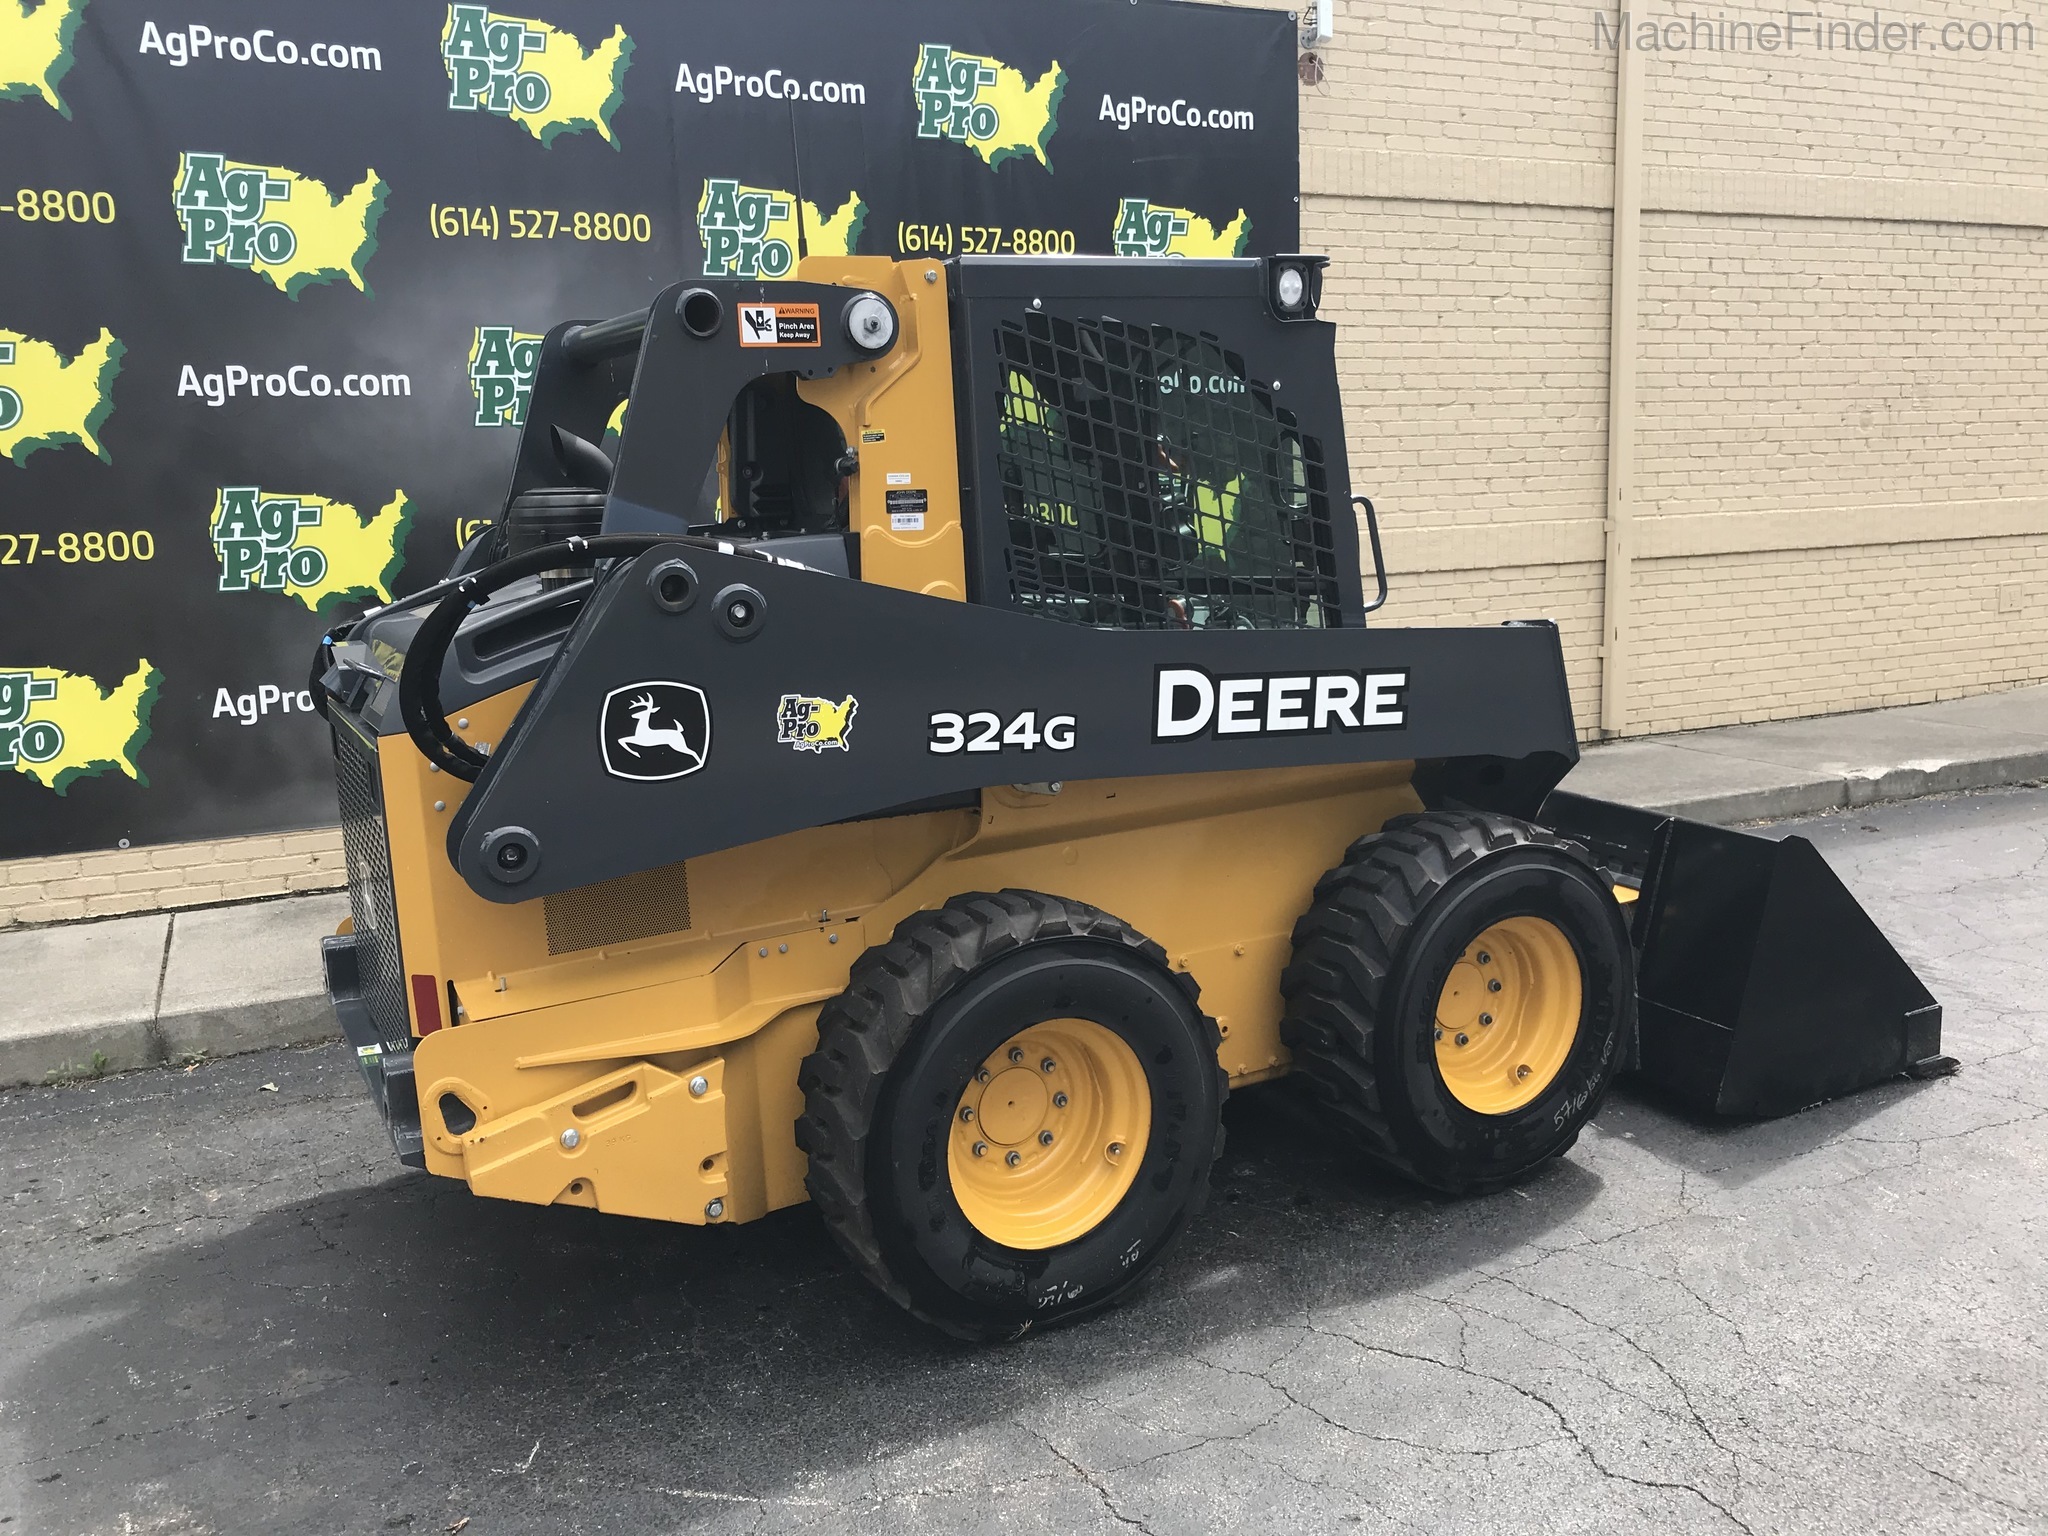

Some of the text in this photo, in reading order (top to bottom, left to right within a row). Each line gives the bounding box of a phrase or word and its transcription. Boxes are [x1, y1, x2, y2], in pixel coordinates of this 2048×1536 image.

[138, 20, 382, 71] AgProCo.com
[445, 4, 546, 72] Ag-
[449, 57, 550, 113] Pro
[674, 62, 866, 105] AgProCo.com
[915, 44, 997, 103] Ag-
[918, 90, 998, 140] Pro
[1098, 93, 1254, 131] AgProCo.com
[0, 188, 116, 224] -8800
[176, 152, 289, 222] Ag-
[699, 179, 789, 240] Ag-
[183, 207, 296, 264] Pro
[429, 203, 651, 242] (614) 527-8800
[897, 221, 1075, 256] (614) 527-8800
[1115, 198, 1189, 253] Ag-
[703, 228, 792, 276] Pro
[778, 322, 815, 330] Pinch Area
[177, 364, 412, 407] AgProCo.com
[213, 487, 321, 549] Ag-
[0, 530, 155, 565] 27-8800
[219, 538, 327, 591] Pro
[781, 697, 820, 722] Ag-
[1157, 669, 1406, 737] DEERE
[781, 718, 820, 739] Pro
[794, 740, 839, 749] AgProCo.com
[929, 711, 1076, 753] 324G
